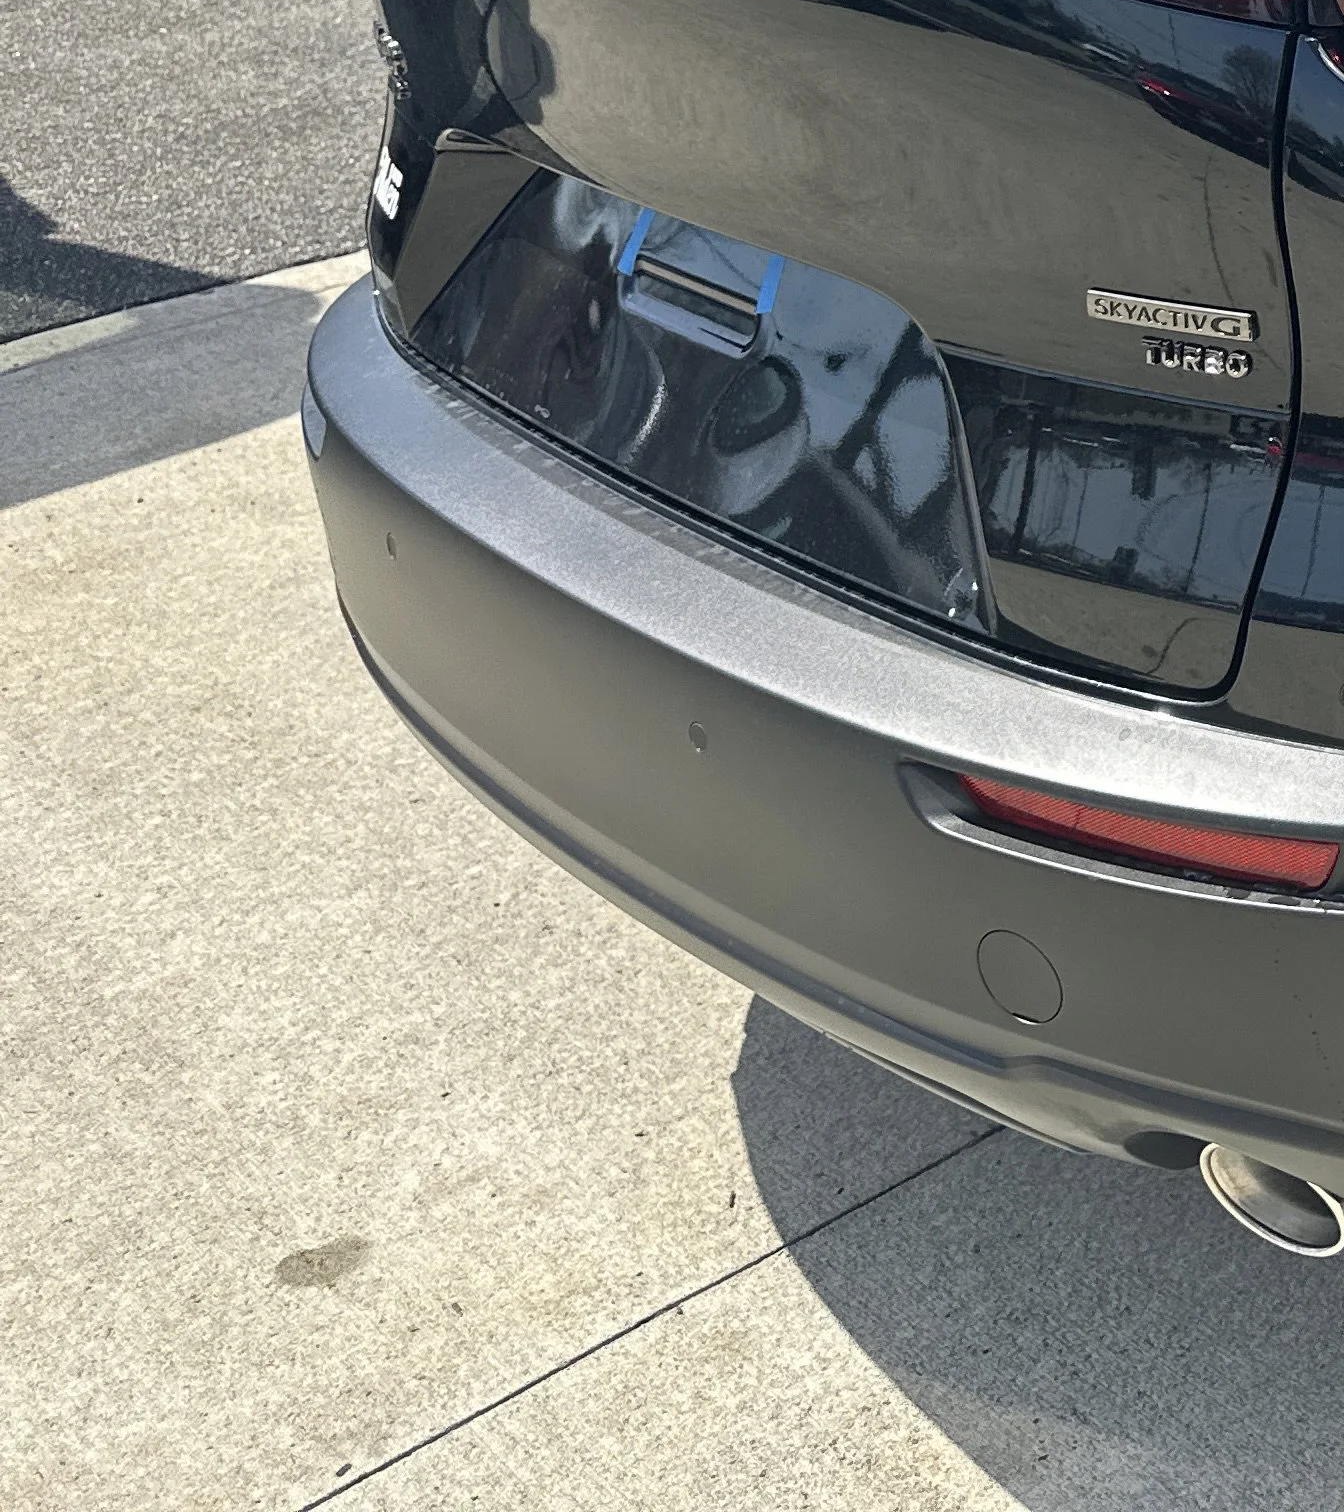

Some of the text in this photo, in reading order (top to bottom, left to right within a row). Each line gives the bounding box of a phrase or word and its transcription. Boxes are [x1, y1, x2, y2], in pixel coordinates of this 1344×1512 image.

[1094, 297, 1241, 337] SKYACTIV G
[1141, 336, 1253, 379] TURBO
